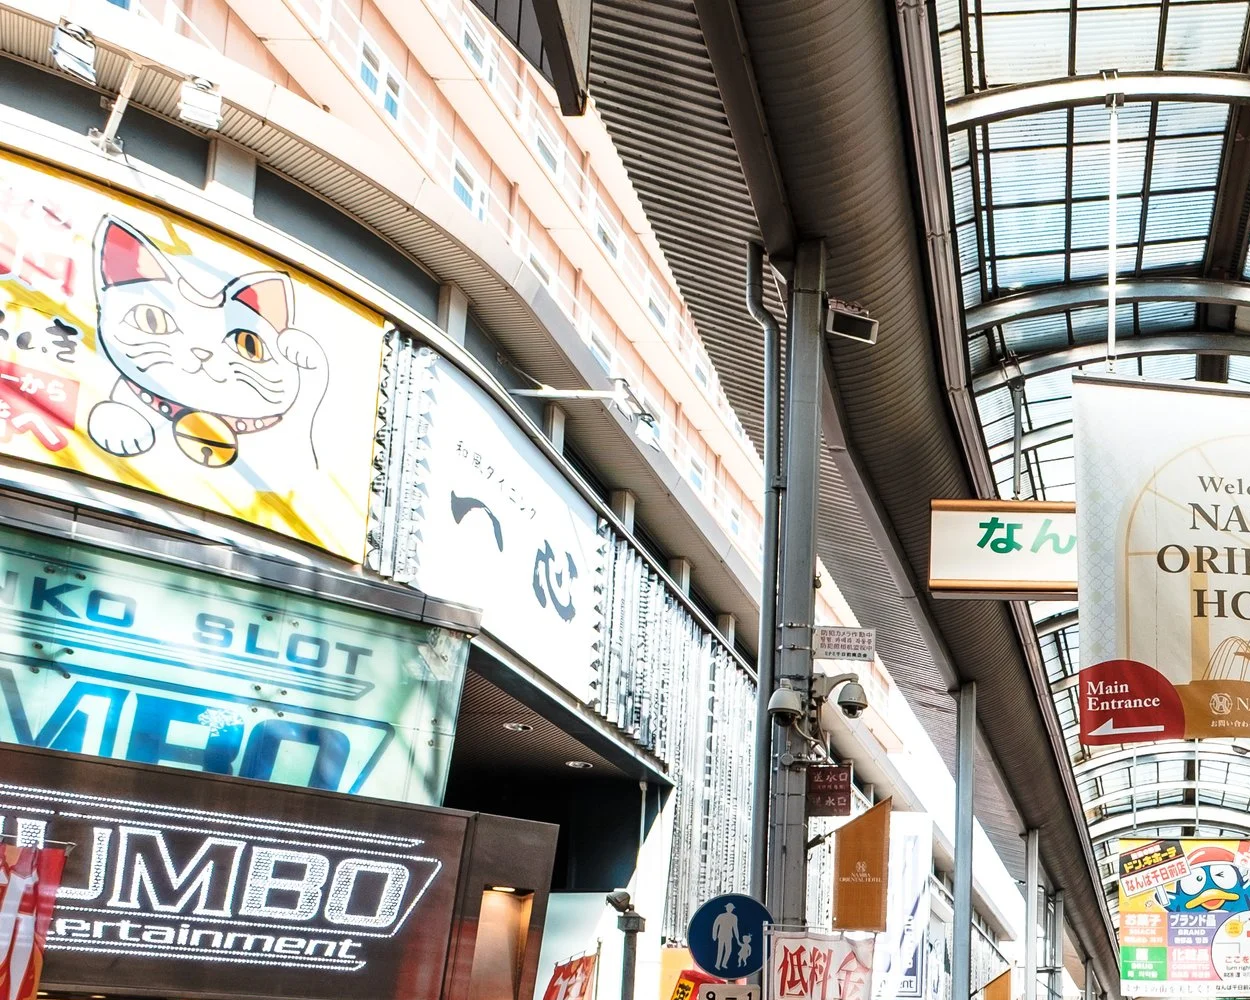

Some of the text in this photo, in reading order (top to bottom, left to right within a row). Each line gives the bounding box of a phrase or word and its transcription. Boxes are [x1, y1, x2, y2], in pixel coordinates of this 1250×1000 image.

[193, 615, 373, 678] SLOT
[1087, 680, 1130, 695] Main
[1087, 696, 1161, 711] Entrance
[2, 816, 410, 928] UMBO
[1125, 861, 1188, 892] なんば千日前店
[1170, 914, 1217, 927] ブランド品
[779, 944, 872, 1000] 低料金
